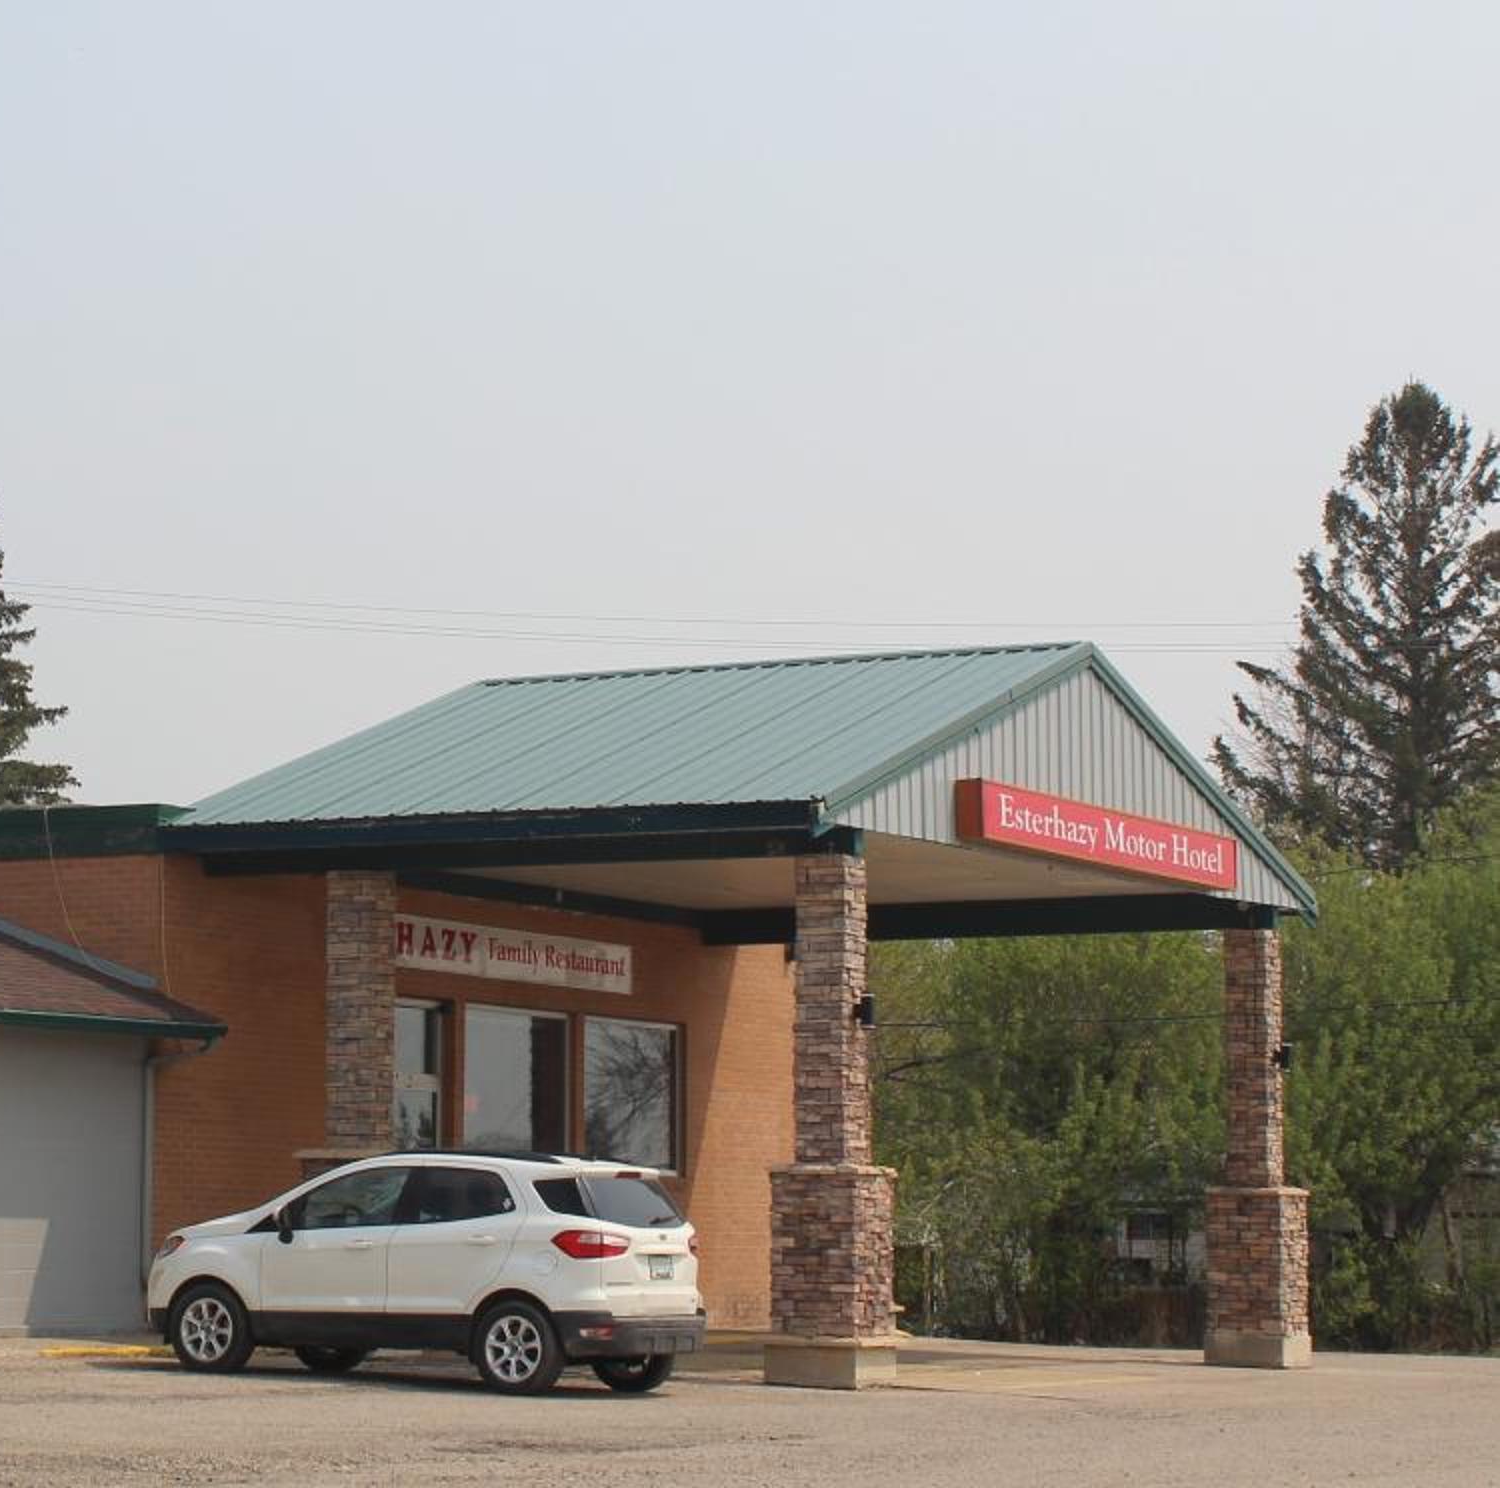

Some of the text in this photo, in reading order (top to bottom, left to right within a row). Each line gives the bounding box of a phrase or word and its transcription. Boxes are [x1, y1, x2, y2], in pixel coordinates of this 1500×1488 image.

[998, 793, 1223, 874] Esterhazy Motor Hotel
[486, 936, 541, 974] Family
[545, 944, 626, 977] Restaurant
